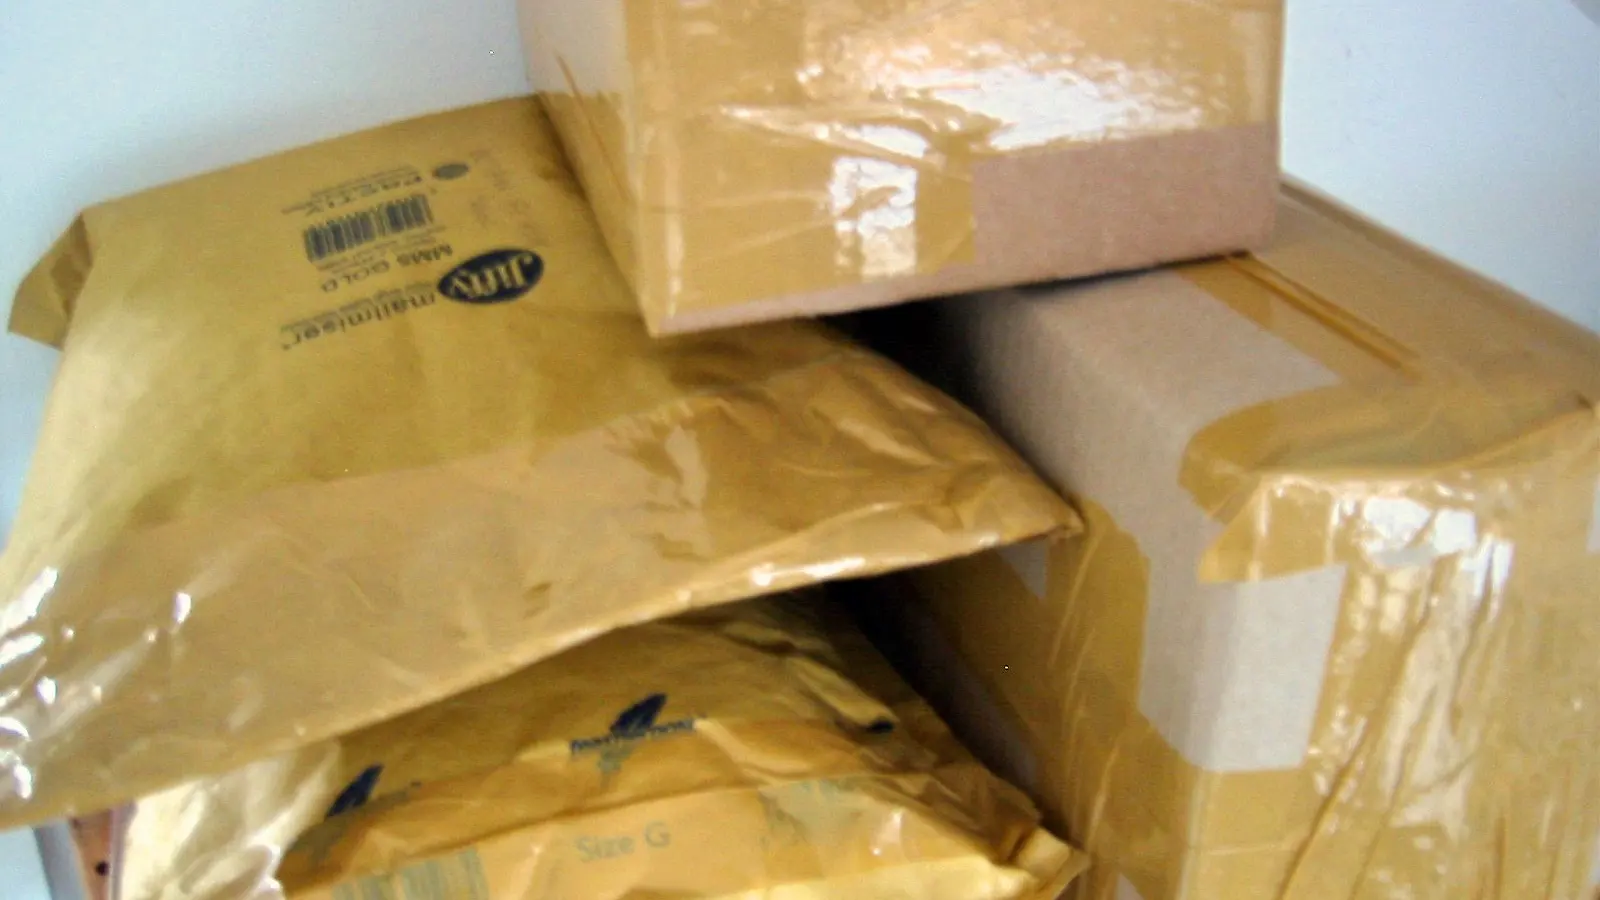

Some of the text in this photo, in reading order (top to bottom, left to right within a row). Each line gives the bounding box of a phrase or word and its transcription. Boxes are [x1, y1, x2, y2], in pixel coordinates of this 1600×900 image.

[451, 252, 534, 299] Jiffy
[284, 291, 436, 348] mailmiser
[574, 820, 672, 863] Size G
